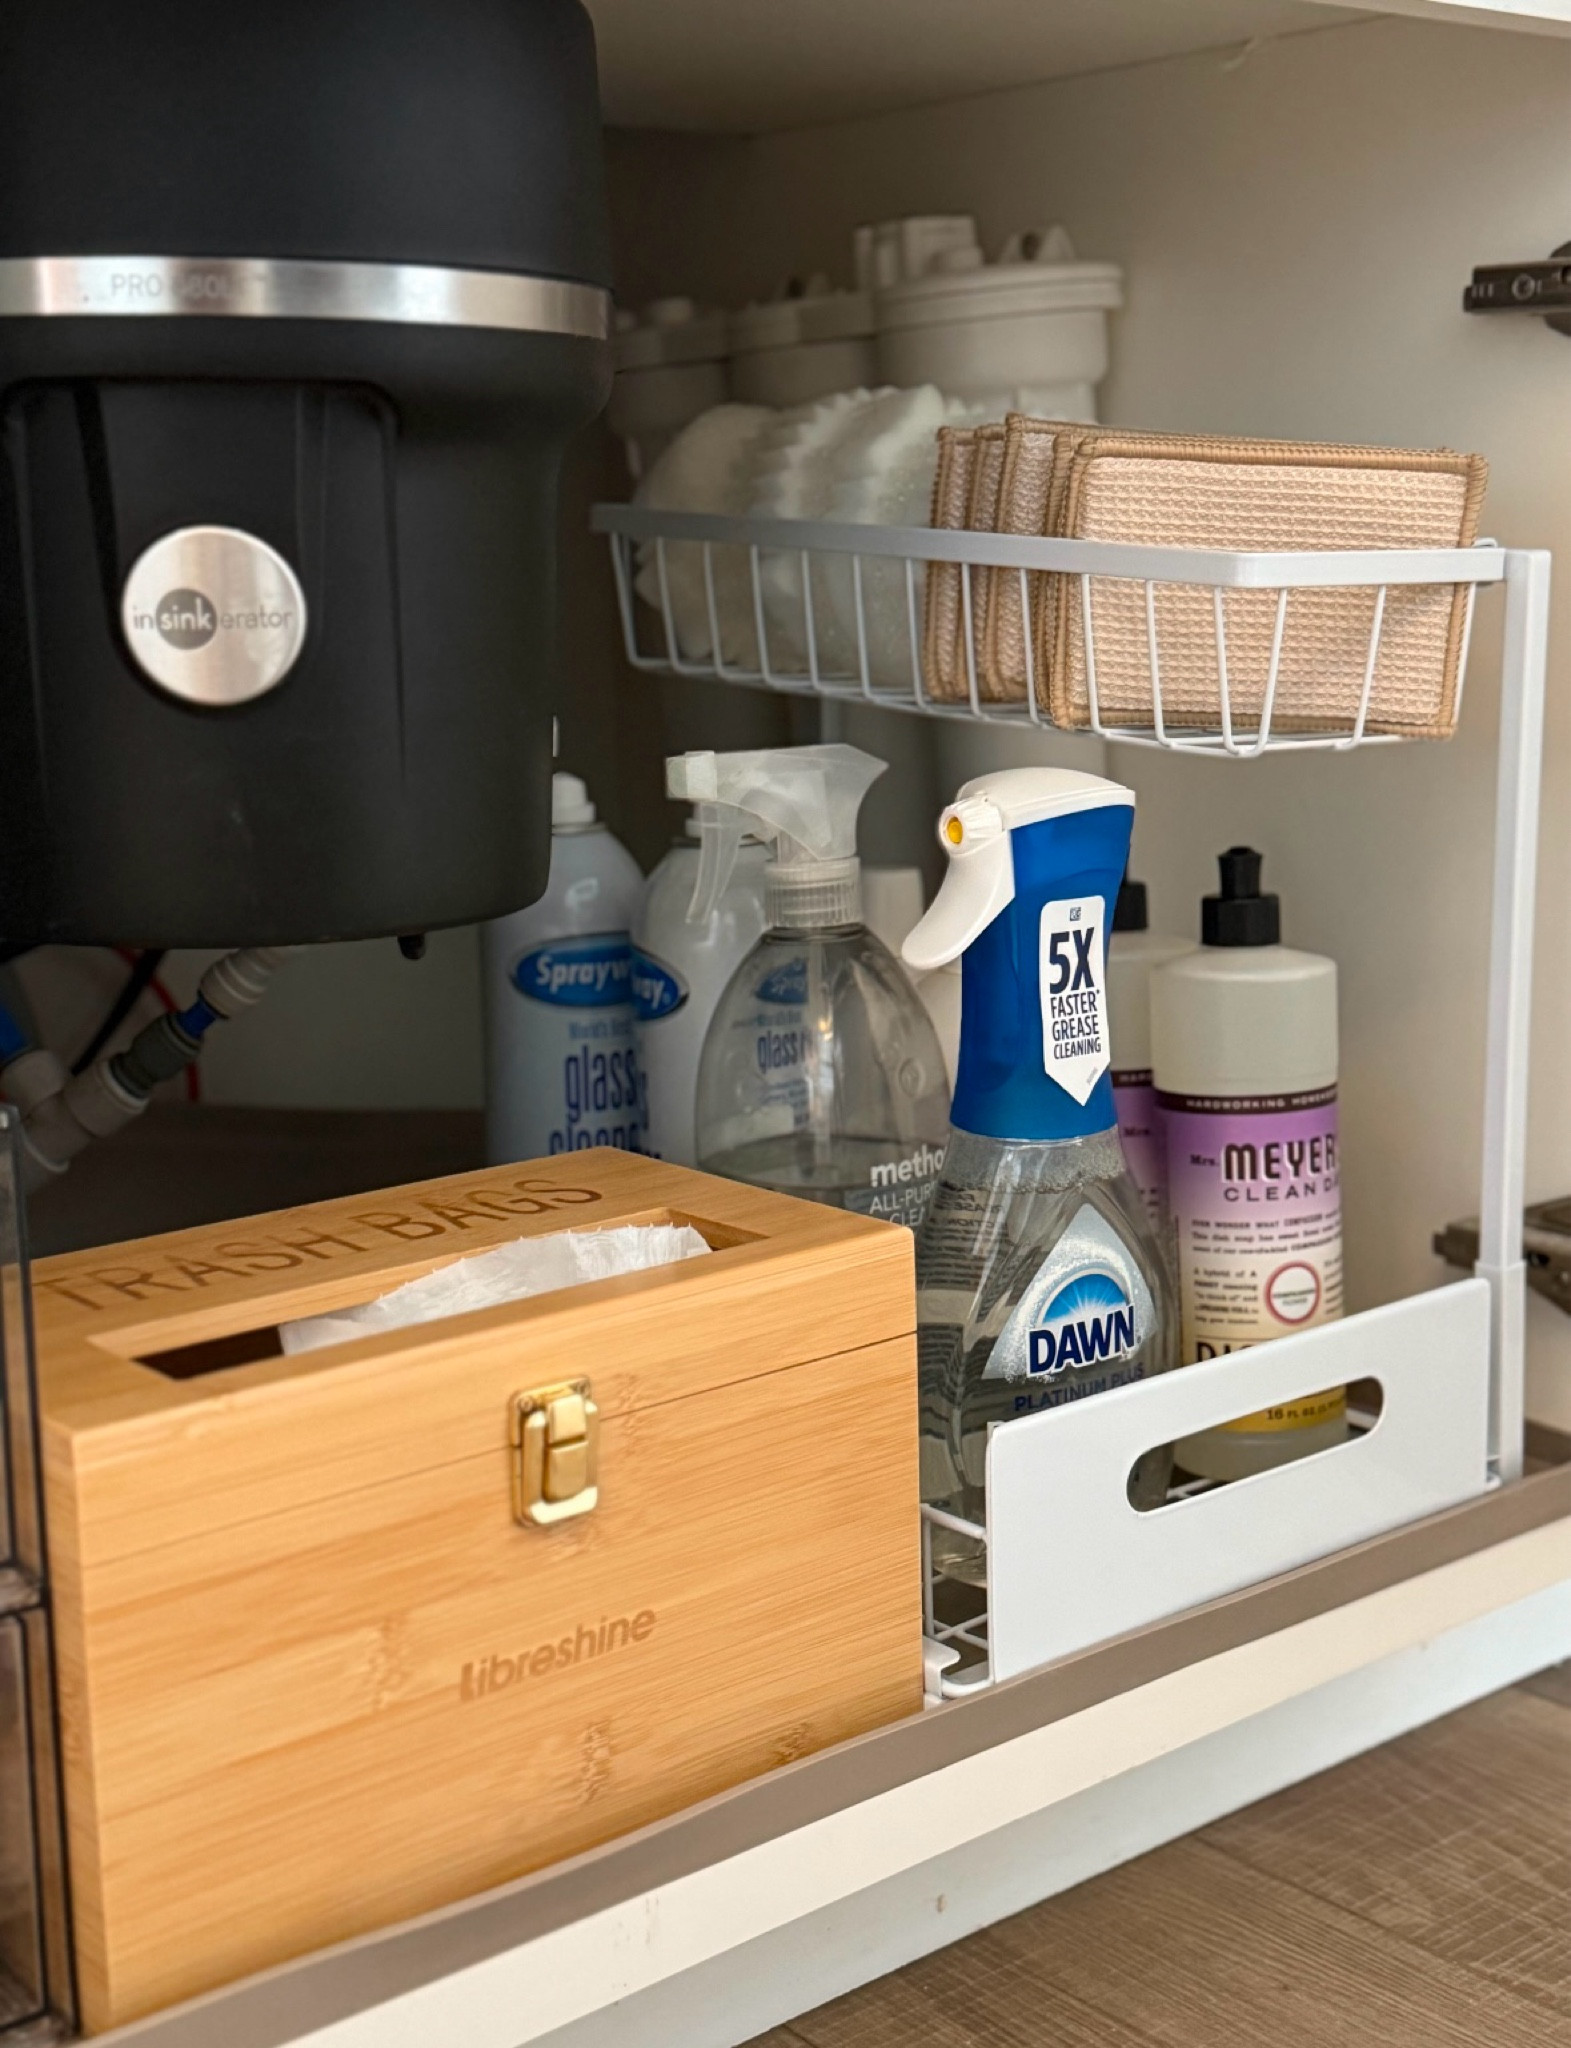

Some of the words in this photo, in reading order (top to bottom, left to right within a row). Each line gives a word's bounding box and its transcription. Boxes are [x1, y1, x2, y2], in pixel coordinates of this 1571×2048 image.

[111, 273, 162, 298] PRO
[133, 598, 293, 630] insinkerator
[1049, 918, 1095, 994] 5X
[1052, 1014, 1099, 1041] GREASE
[1053, 1036, 1101, 1060] CLEANING
[565, 1045, 637, 1122] glass
[870, 1144, 948, 1188] metho
[1190, 1154, 1220, 1167] Mrs.
[1222, 1133, 1336, 1182] MEYER
[1223, 1182, 1316, 1202] CLEAN
[32, 1226, 368, 1312] TRASH
[351, 1178, 603, 1242] BAGS
[1029, 1305, 1135, 1374] DAWN
[1014, 1369, 1107, 1411] PLATINUM
[1111, 1362, 1144, 1387] PLUS
